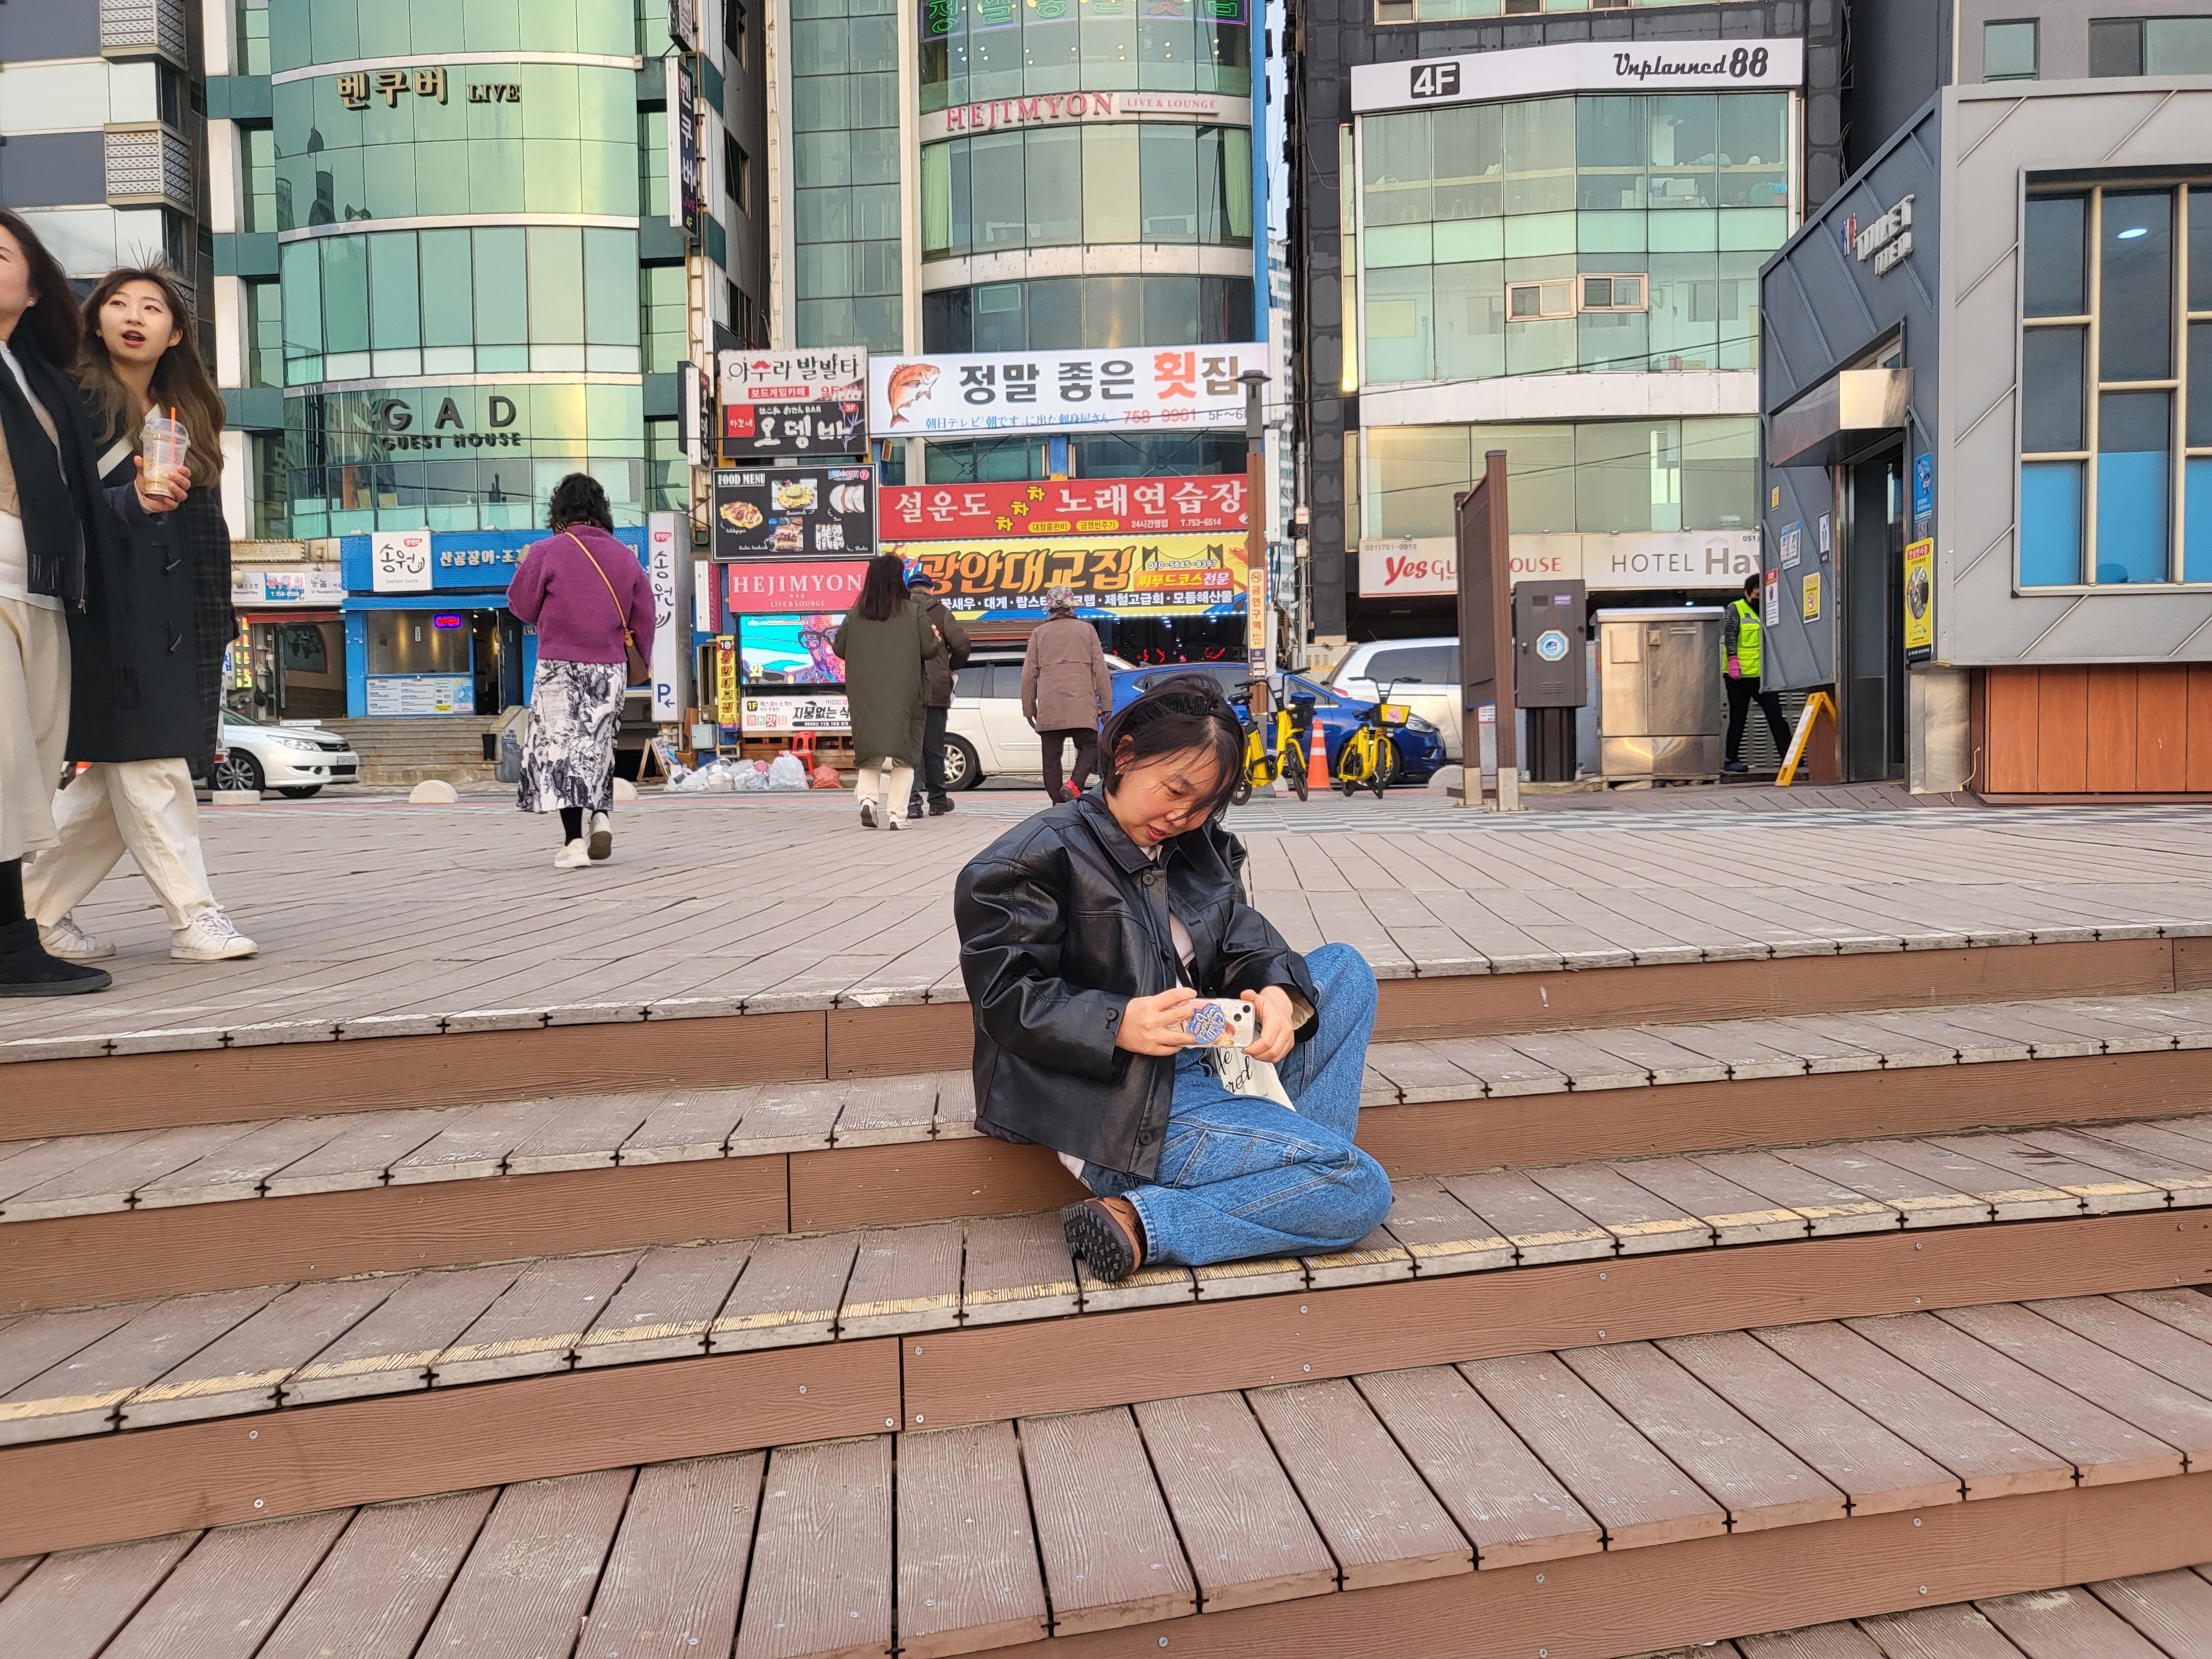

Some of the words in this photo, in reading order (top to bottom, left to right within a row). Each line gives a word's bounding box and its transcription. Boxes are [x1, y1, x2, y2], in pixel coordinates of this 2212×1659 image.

[1613, 53, 1727, 81] Unplanned
[1729, 48, 1768, 78] 88
[336, 67, 448, 111] 벤쿠버
[467, 84, 520, 103] LIVE
[1413, 64, 1456, 96] 4F
[946, 91, 1114, 131] HEJIMYON
[1126, 98, 1152, 108] LIVE
[1156, 99, 1164, 108] &
[1167, 100, 1216, 109] LOUNGE
[727, 357, 792, 384] 아수라
[796, 353, 859, 380] 발발타
[959, 362, 1040, 405] 정말
[1057, 361, 1135, 402] 좋은
[1154, 351, 1239, 399] 횟집
[751, 387, 806, 398] 보드게임카페
[380, 395, 517, 432] GAD
[805, 405, 822, 414] BAR
[1123, 410, 1151, 424] 758
[382, 434, 441, 452] GUEST
[454, 432, 521, 448] HOUSE
[753, 414, 851, 449] 오뎅바
[718, 473, 741, 486] FOOD
[742, 472, 766, 485] MENU
[894, 491, 992, 524] 설운도
[1055, 480, 1248, 517] 노래연습장
[1079, 520, 1116, 530] 금영반주기
[1131, 518, 1169, 529] 24시간영업
[1180, 517, 1222, 528] T.753-6514
[921, 545, 1135, 596] 광안대교집
[1148, 559, 1218, 570] 010-5645-9397
[1384, 556, 1428, 587] Yes
[1509, 557, 1562, 573] OUSE
[1611, 553, 1694, 573] HOTEL
[733, 573, 863, 597] HEJIMYON
[984, 596, 1008, 610] 대게
[1104, 592, 1164, 607] 제철고급회
[1173, 589, 1233, 606] 모듬해산물
[1252, 585, 1261, 630] 금연구역
[658, 683, 671, 703] P
[747, 702, 758, 710] 1F
[792, 706, 837, 719] 지붕없는
